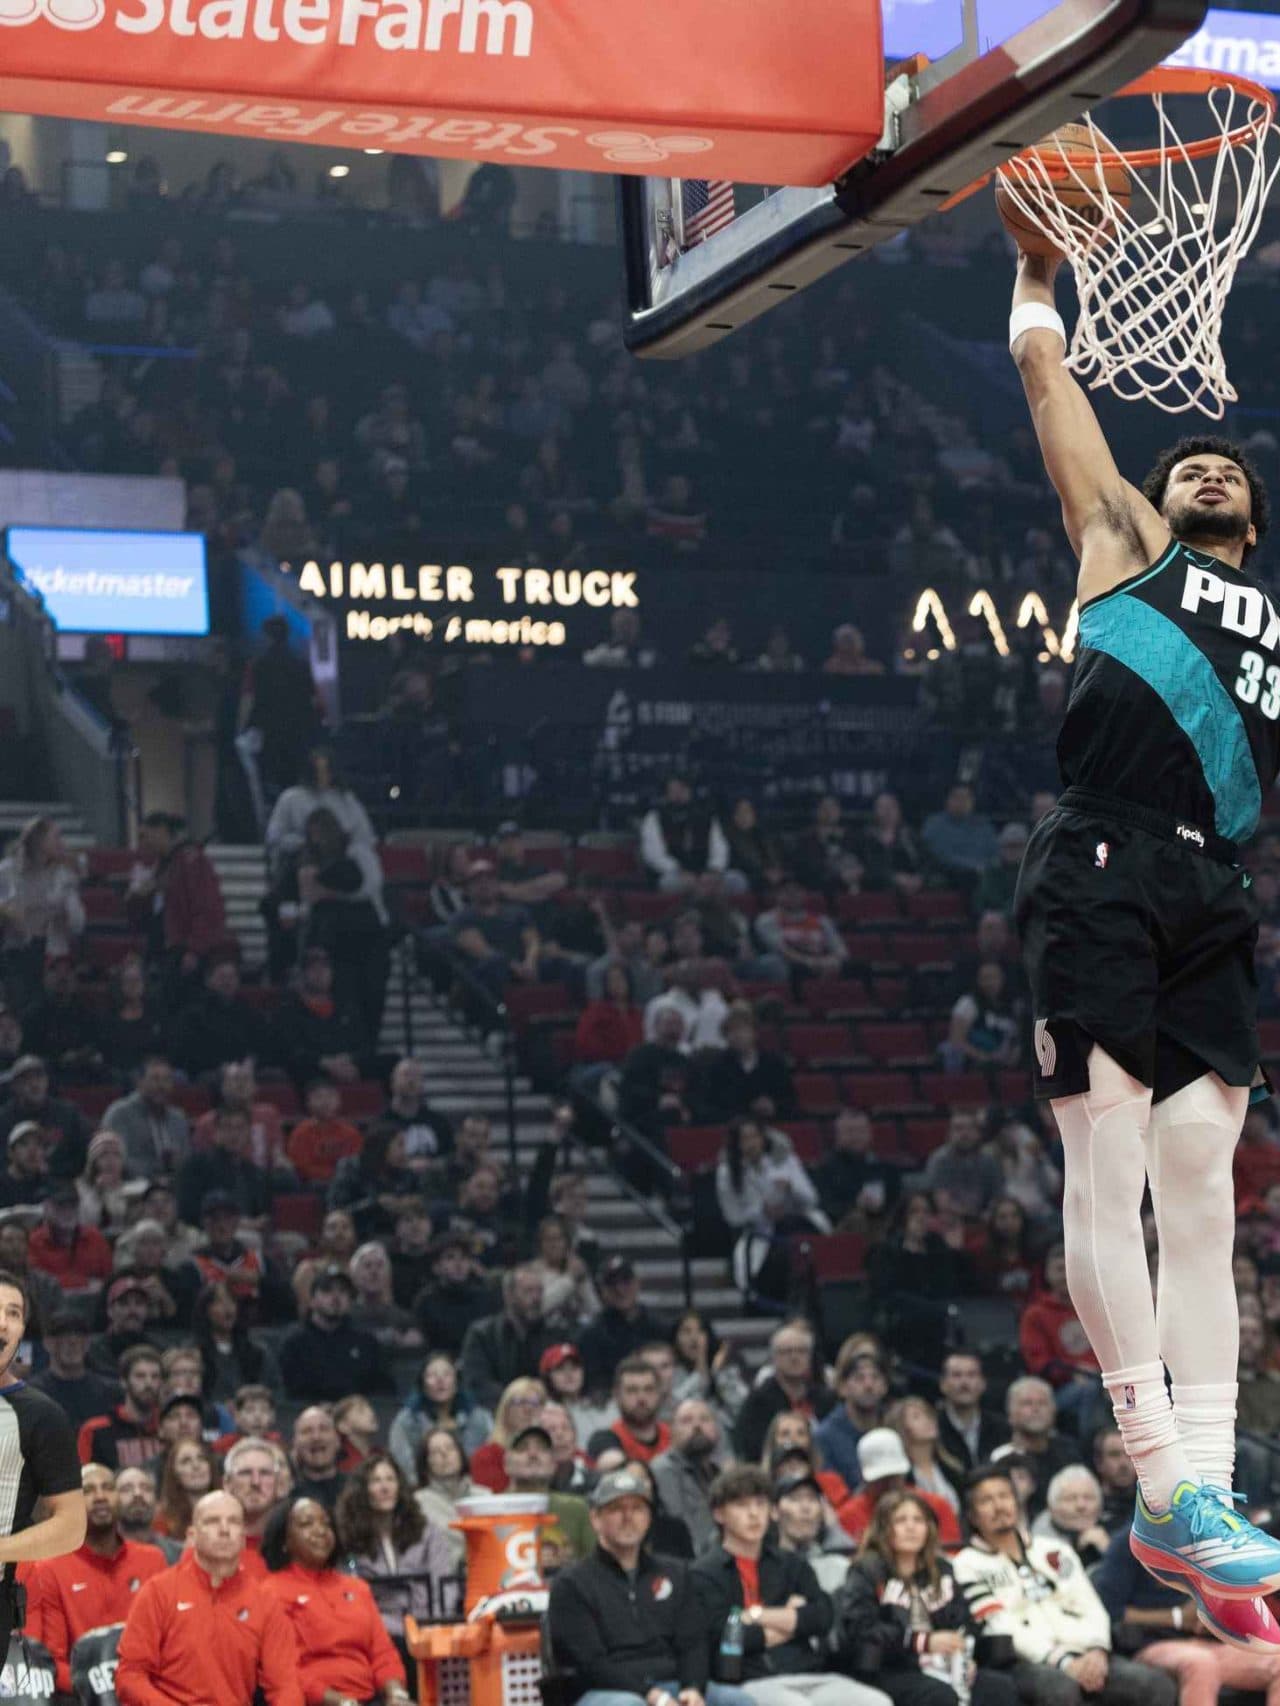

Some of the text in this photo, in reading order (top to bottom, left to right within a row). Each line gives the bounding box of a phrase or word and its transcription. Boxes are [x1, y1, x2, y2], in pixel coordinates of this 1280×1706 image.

[299, 560, 640, 608] AIMLER TRUCK
[1176, 825, 1205, 848] ripcity
